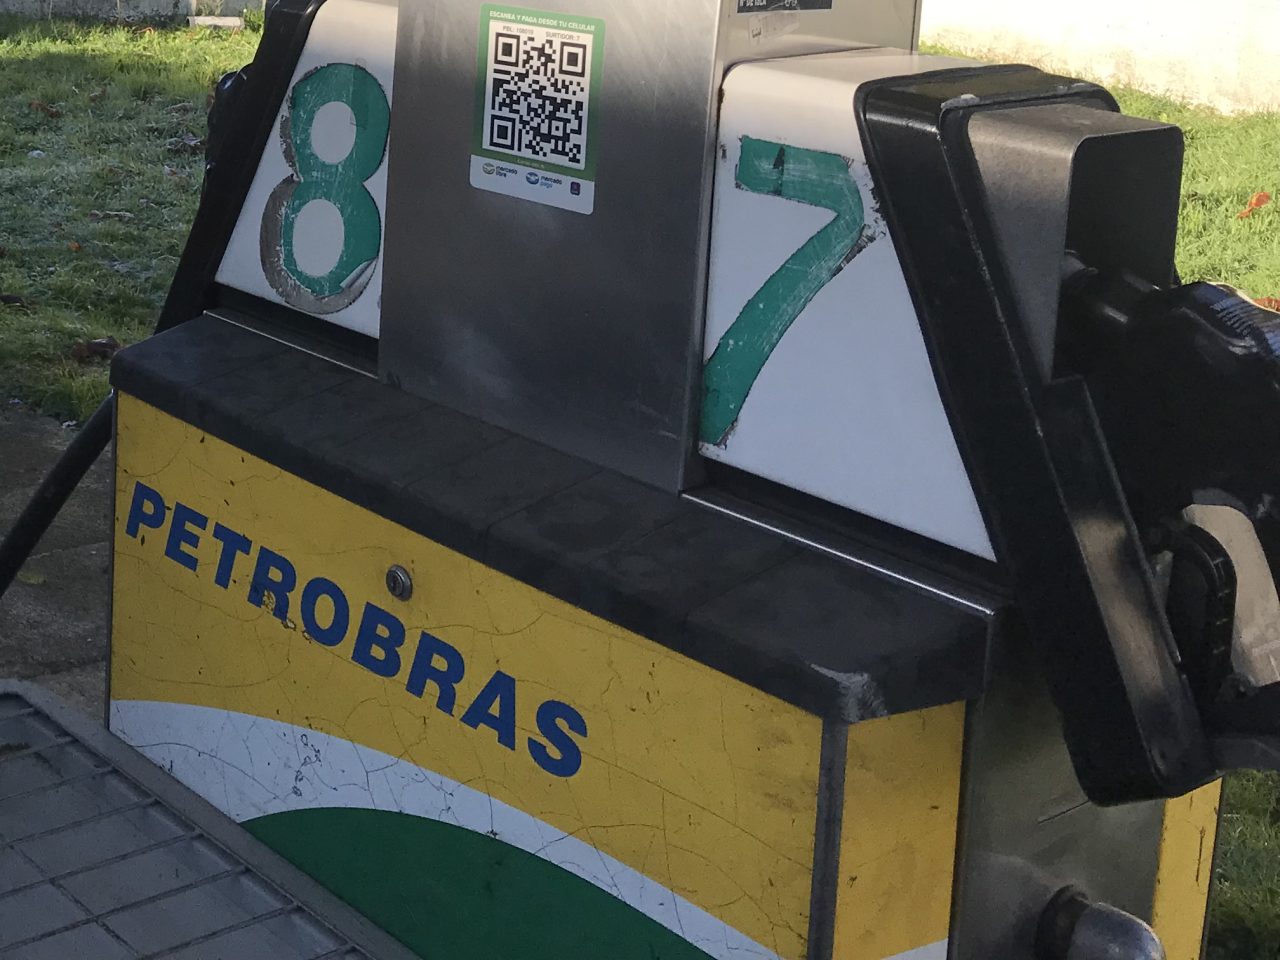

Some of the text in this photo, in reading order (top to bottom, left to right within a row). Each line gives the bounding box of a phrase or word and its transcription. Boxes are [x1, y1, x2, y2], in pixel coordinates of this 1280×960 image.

[521, 15, 537, 24] PAGA
[538, 17, 558, 27] DESDE
[559, 20, 568, 28] TU
[568, 22, 595, 31] CELULAR
[260, 62, 390, 314] 8
[699, 134, 865, 445] 7
[125, 480, 588, 777] PETROBRAS
